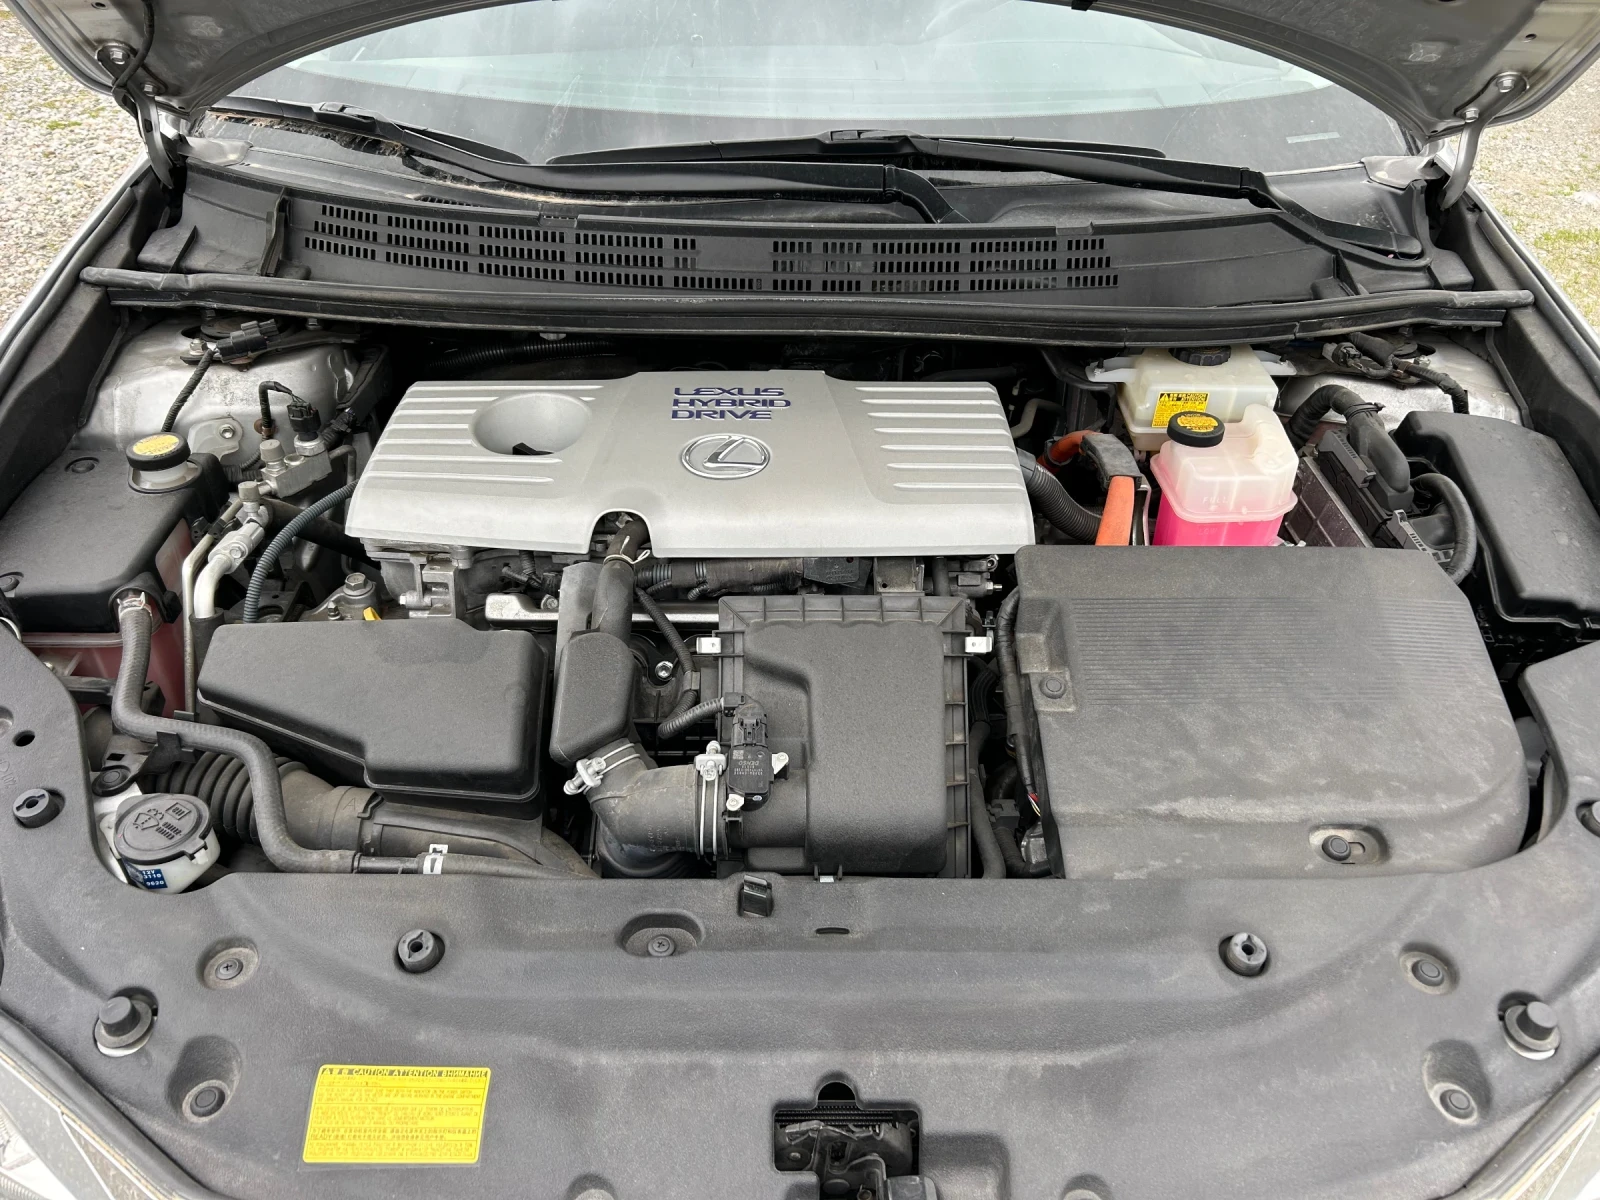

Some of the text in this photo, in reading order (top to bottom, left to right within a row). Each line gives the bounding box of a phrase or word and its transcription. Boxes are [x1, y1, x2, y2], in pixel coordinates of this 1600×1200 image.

[674, 387, 785, 397] LEXUS
[673, 399, 791, 408] HYBRID
[672, 410, 772, 420] DRIVE
[353, 1068, 390, 1076] CAUTION
[392, 1069, 439, 1077] ATTENTION
